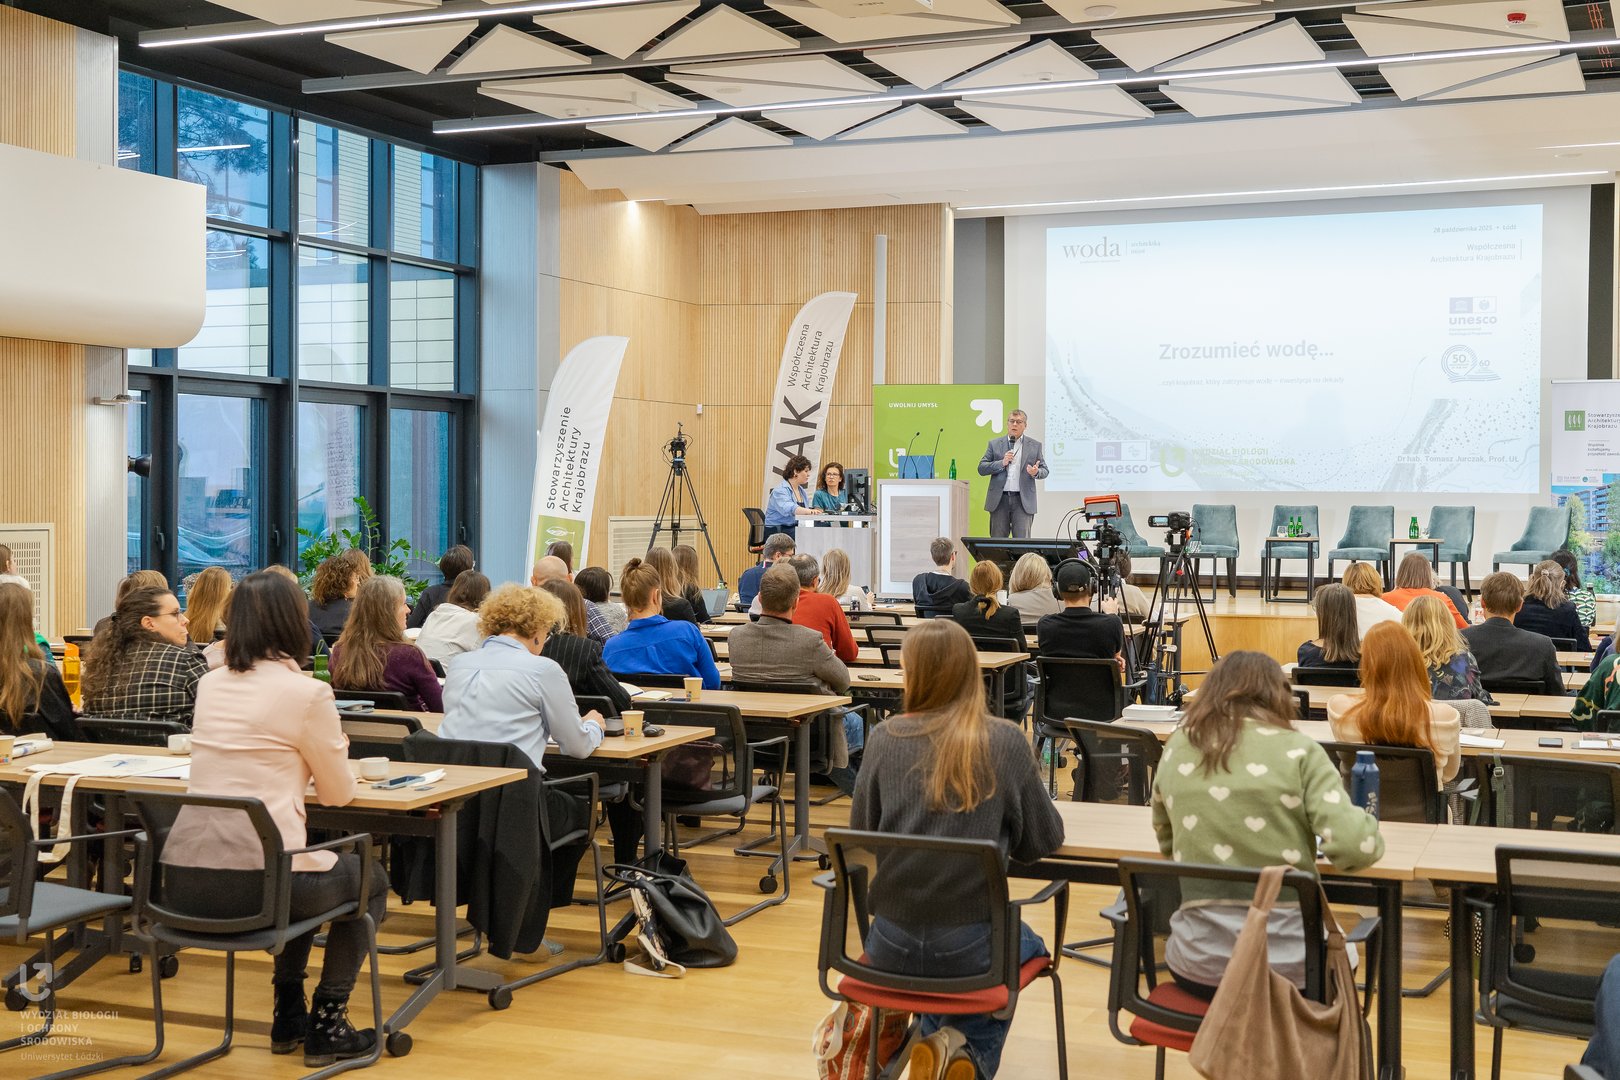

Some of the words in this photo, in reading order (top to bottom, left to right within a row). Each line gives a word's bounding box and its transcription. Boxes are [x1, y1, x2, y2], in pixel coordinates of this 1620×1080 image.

[1062, 236, 1122, 259] woda
[1430, 255, 1474, 263] Architektura
[1448, 316, 1497, 325] unesco
[787, 323, 810, 387] Współczesna
[801, 330, 823, 390] Architektura
[815, 340, 834, 393] Krajobrazu
[1158, 340, 1261, 360] Zrozumieć
[1452, 354, 1467, 363] 50
[547, 406, 571, 510] Stowarzyszenie
[770, 395, 821, 494] AK
[1425, 455, 1453, 463] Tomasz
[1455, 455, 1486, 464] Jurczak,
[559, 426, 582, 512] Architektury
[572, 441, 590, 513] Krajobrazu
[1095, 464, 1149, 474] unesco
